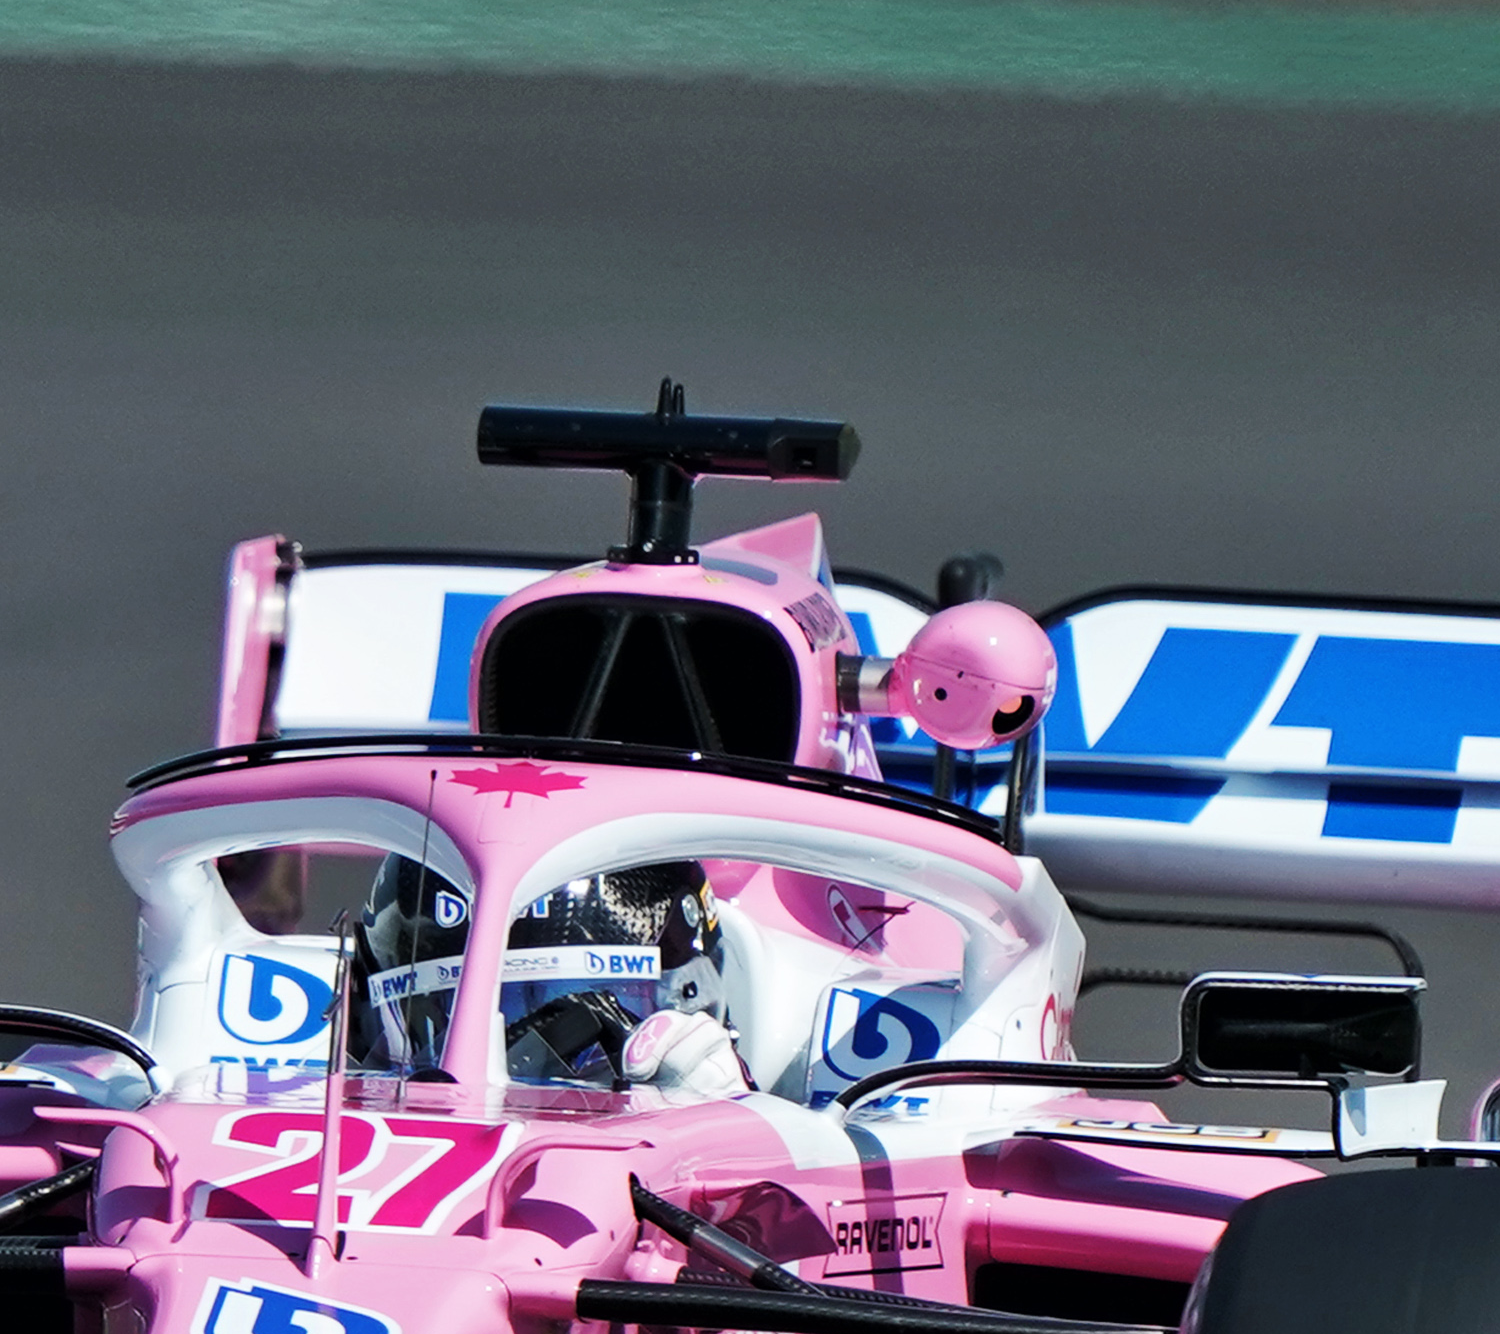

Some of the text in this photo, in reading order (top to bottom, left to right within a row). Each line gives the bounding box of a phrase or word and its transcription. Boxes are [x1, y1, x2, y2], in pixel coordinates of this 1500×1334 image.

[609, 955, 655, 974] BWT
[198, 1110, 514, 1231] 27
[836, 1216, 934, 1255] RAVENOL
